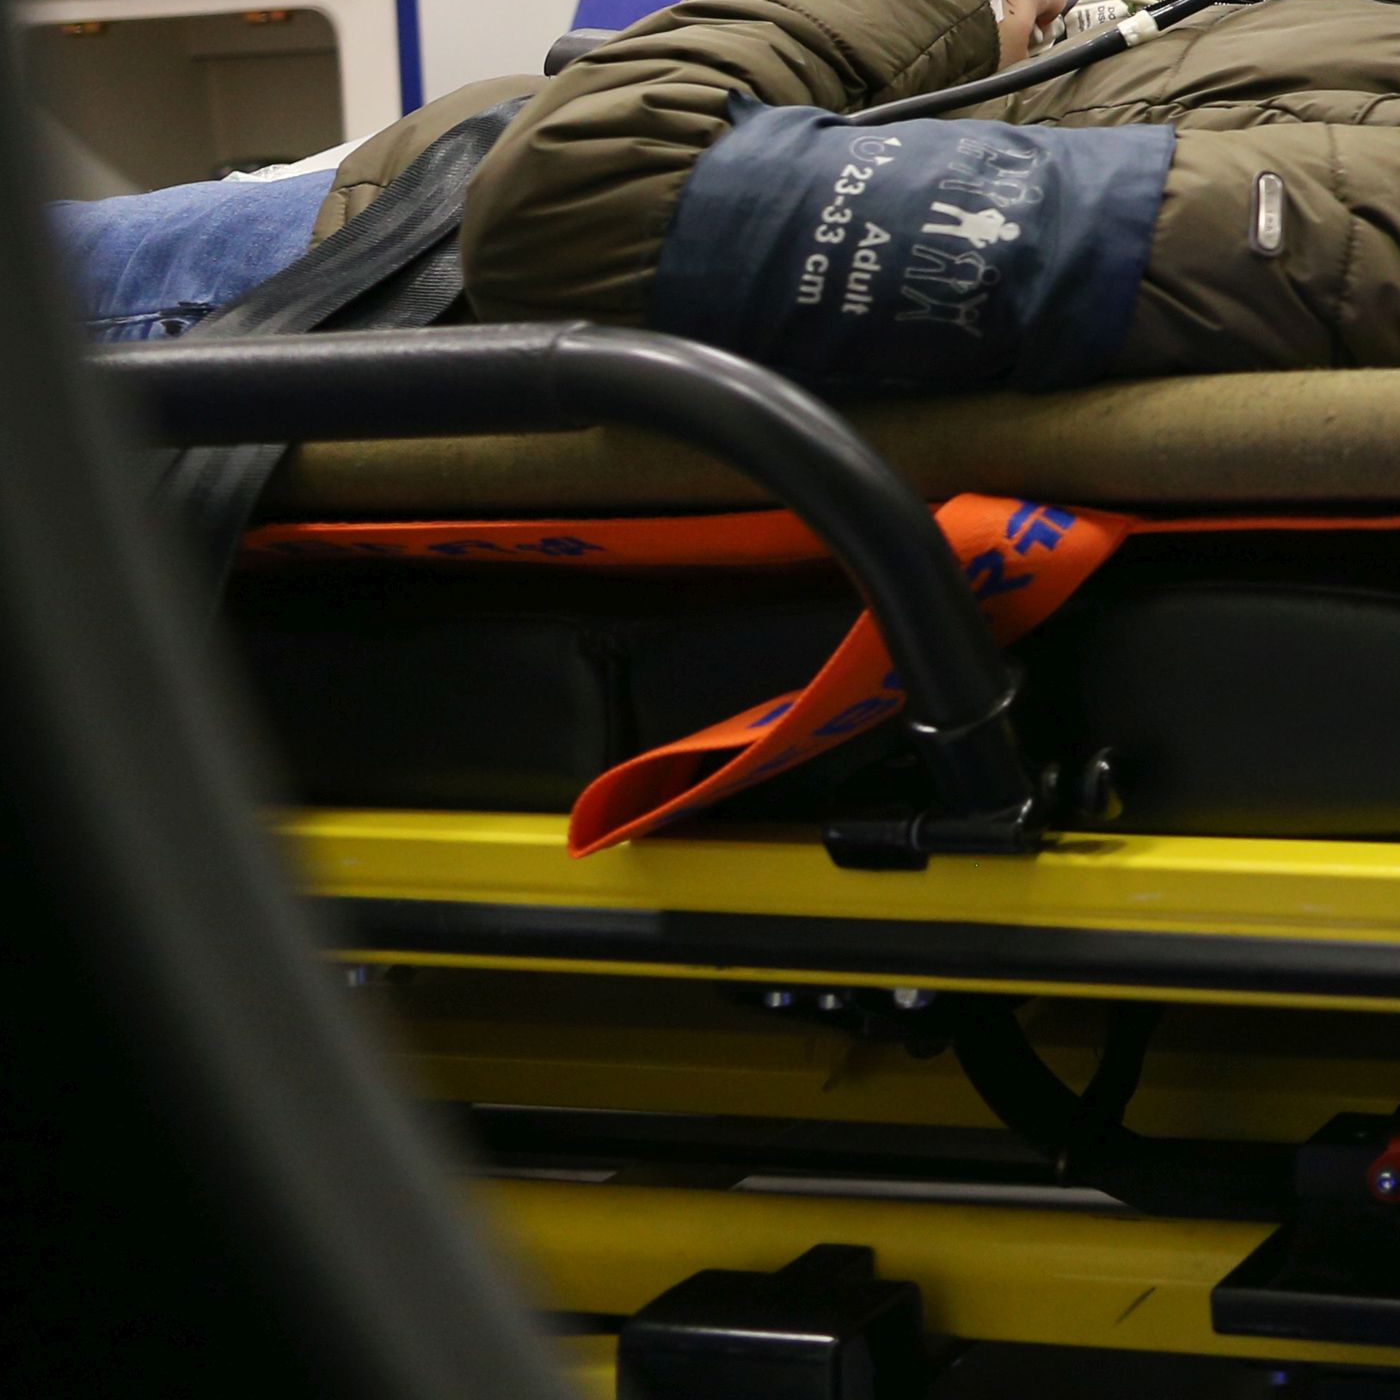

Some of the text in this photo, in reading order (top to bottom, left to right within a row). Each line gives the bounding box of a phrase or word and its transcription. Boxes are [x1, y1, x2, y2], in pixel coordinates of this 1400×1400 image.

[796, 163, 874, 305] 23-33 cm
[841, 221, 892, 315] Adult
